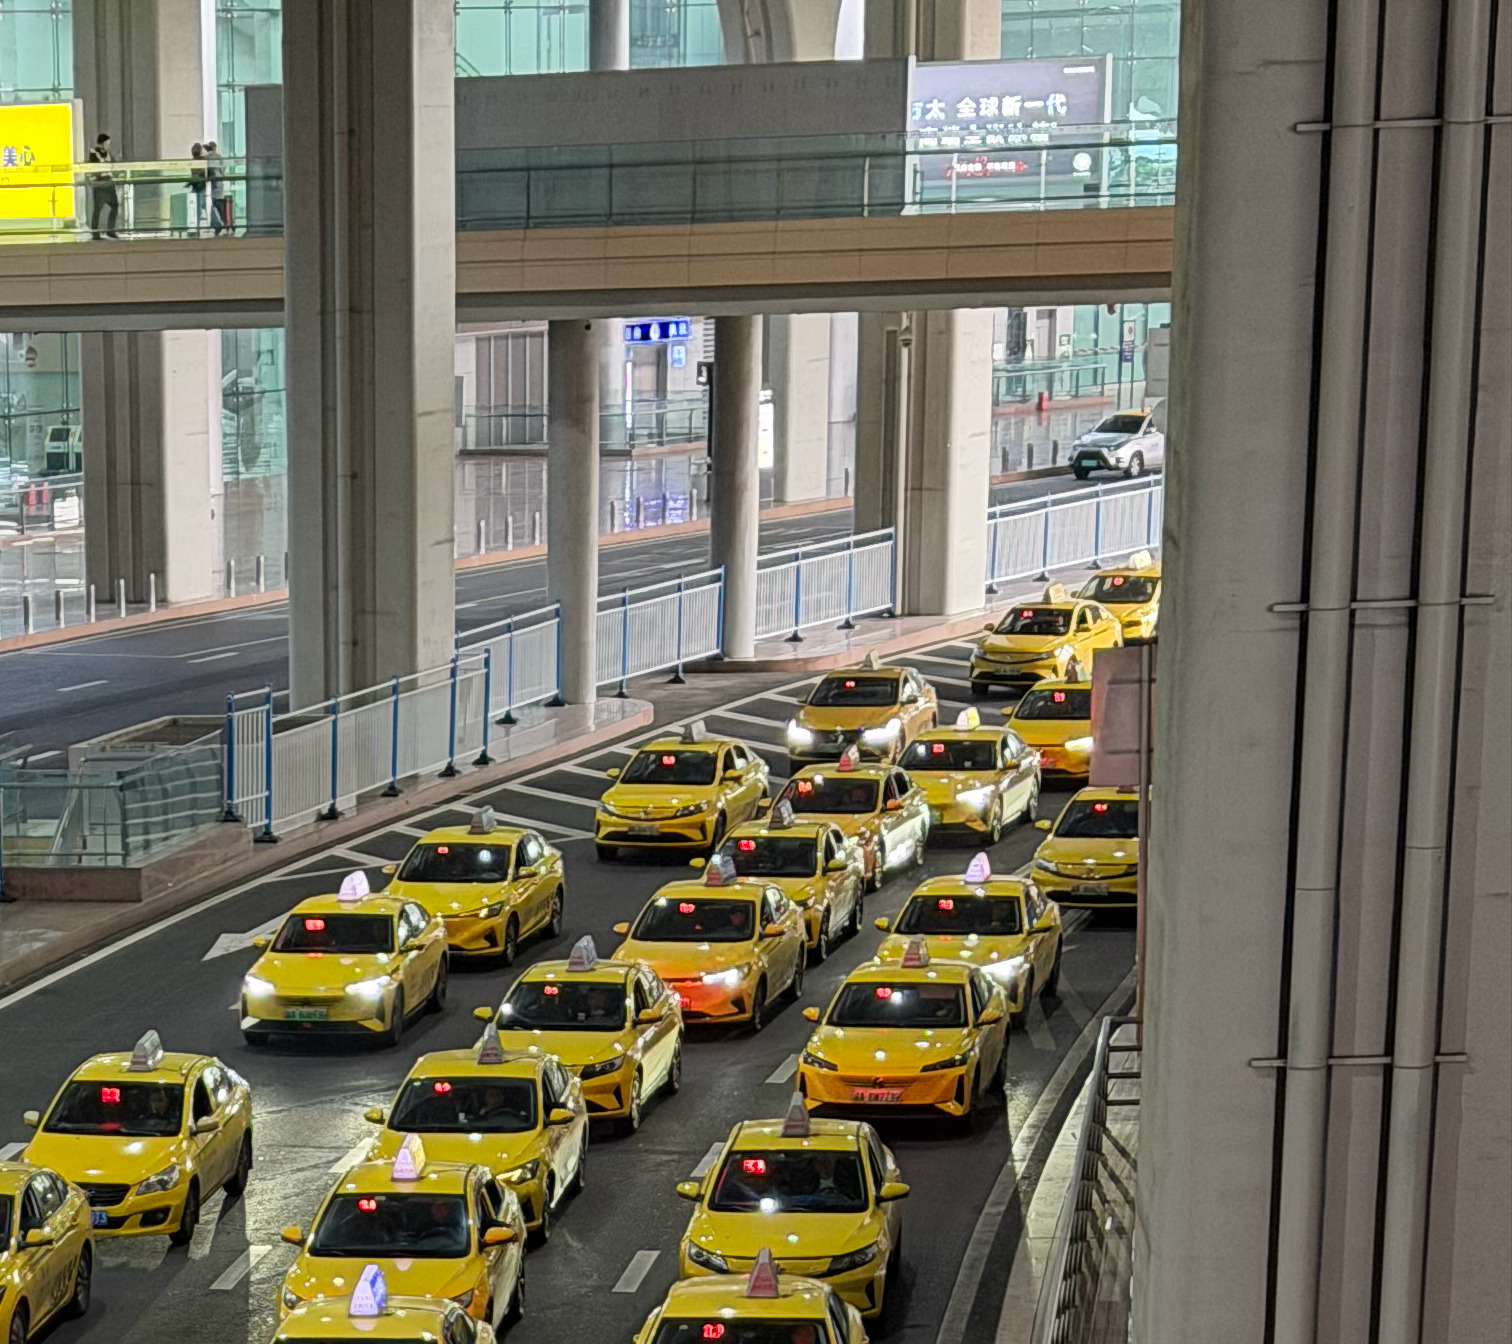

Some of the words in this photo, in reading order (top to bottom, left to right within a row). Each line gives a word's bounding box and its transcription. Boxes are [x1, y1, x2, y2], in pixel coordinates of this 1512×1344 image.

[956, 93, 1068, 118] 全球新一代
[2, 145, 36, 168] 美心
